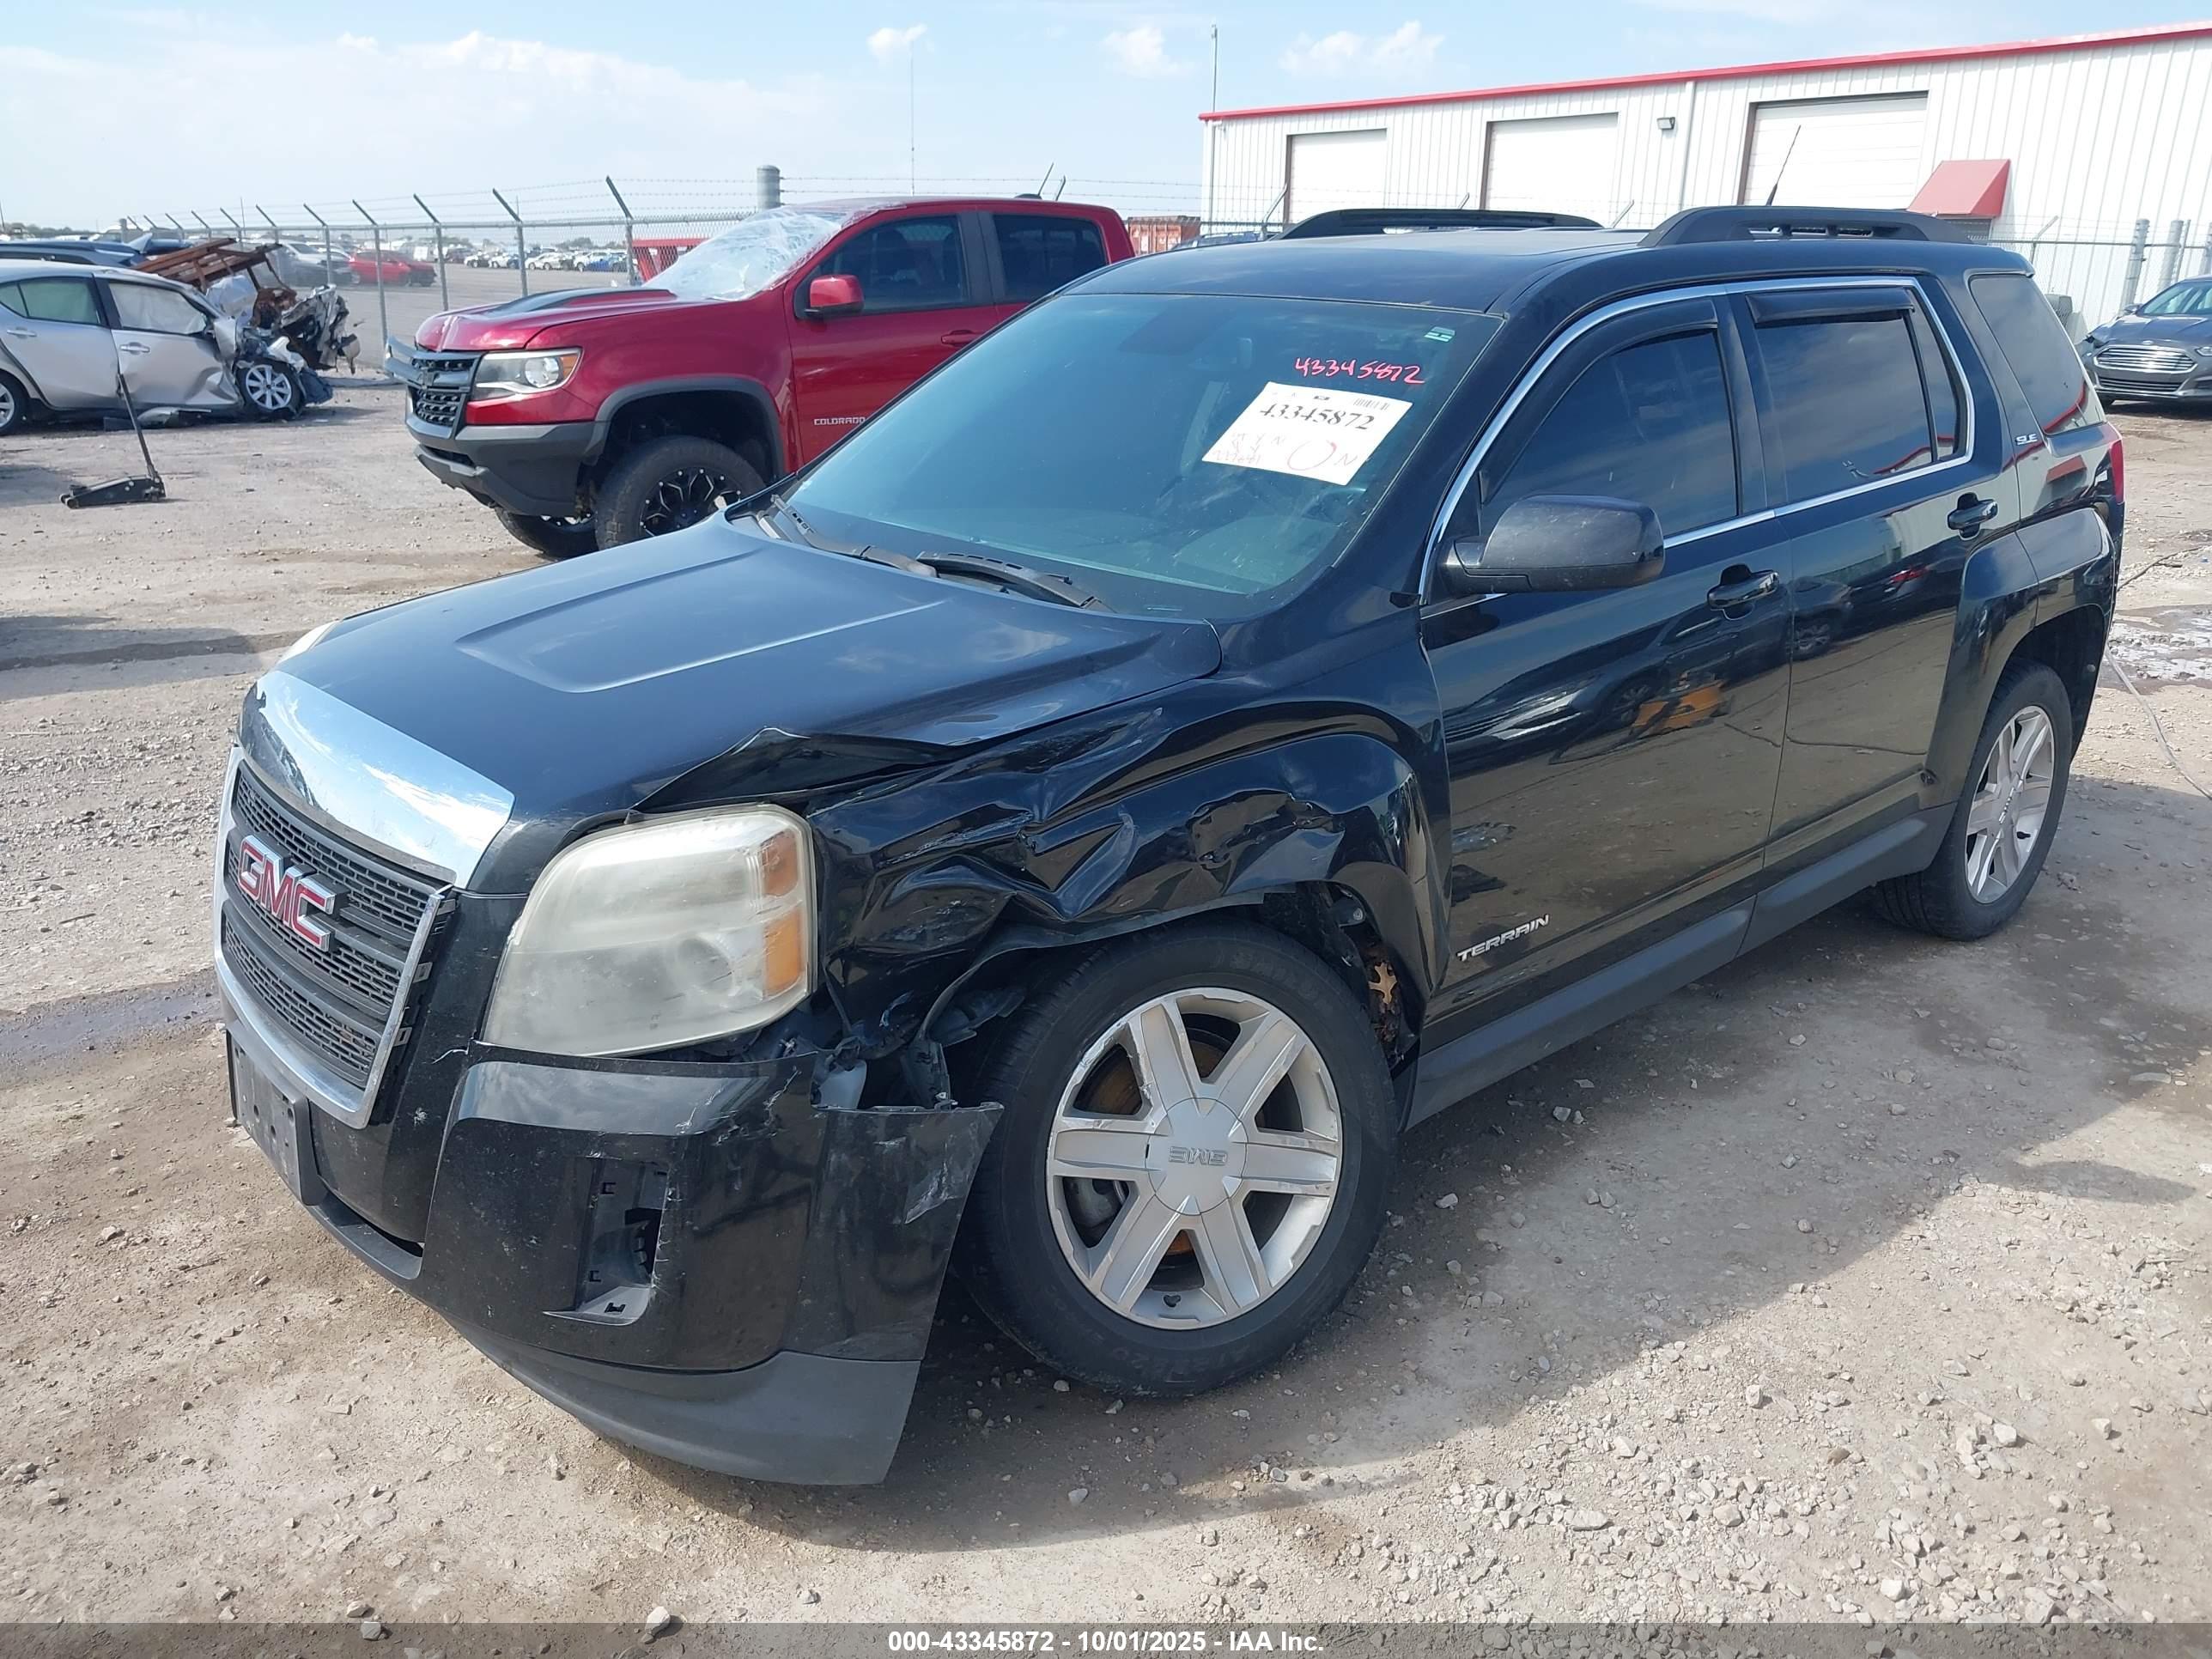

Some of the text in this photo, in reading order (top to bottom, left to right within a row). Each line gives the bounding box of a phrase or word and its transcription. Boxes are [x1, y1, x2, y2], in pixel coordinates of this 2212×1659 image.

[1294, 356, 1425, 384] 43345872
[813, 416, 866, 426] COLORADO
[1260, 403, 1376, 430] 43345872
[238, 835, 336, 952] GMC
[1456, 913, 1550, 962] TERRAIN
[1168, 1146, 1229, 1166] GMC
